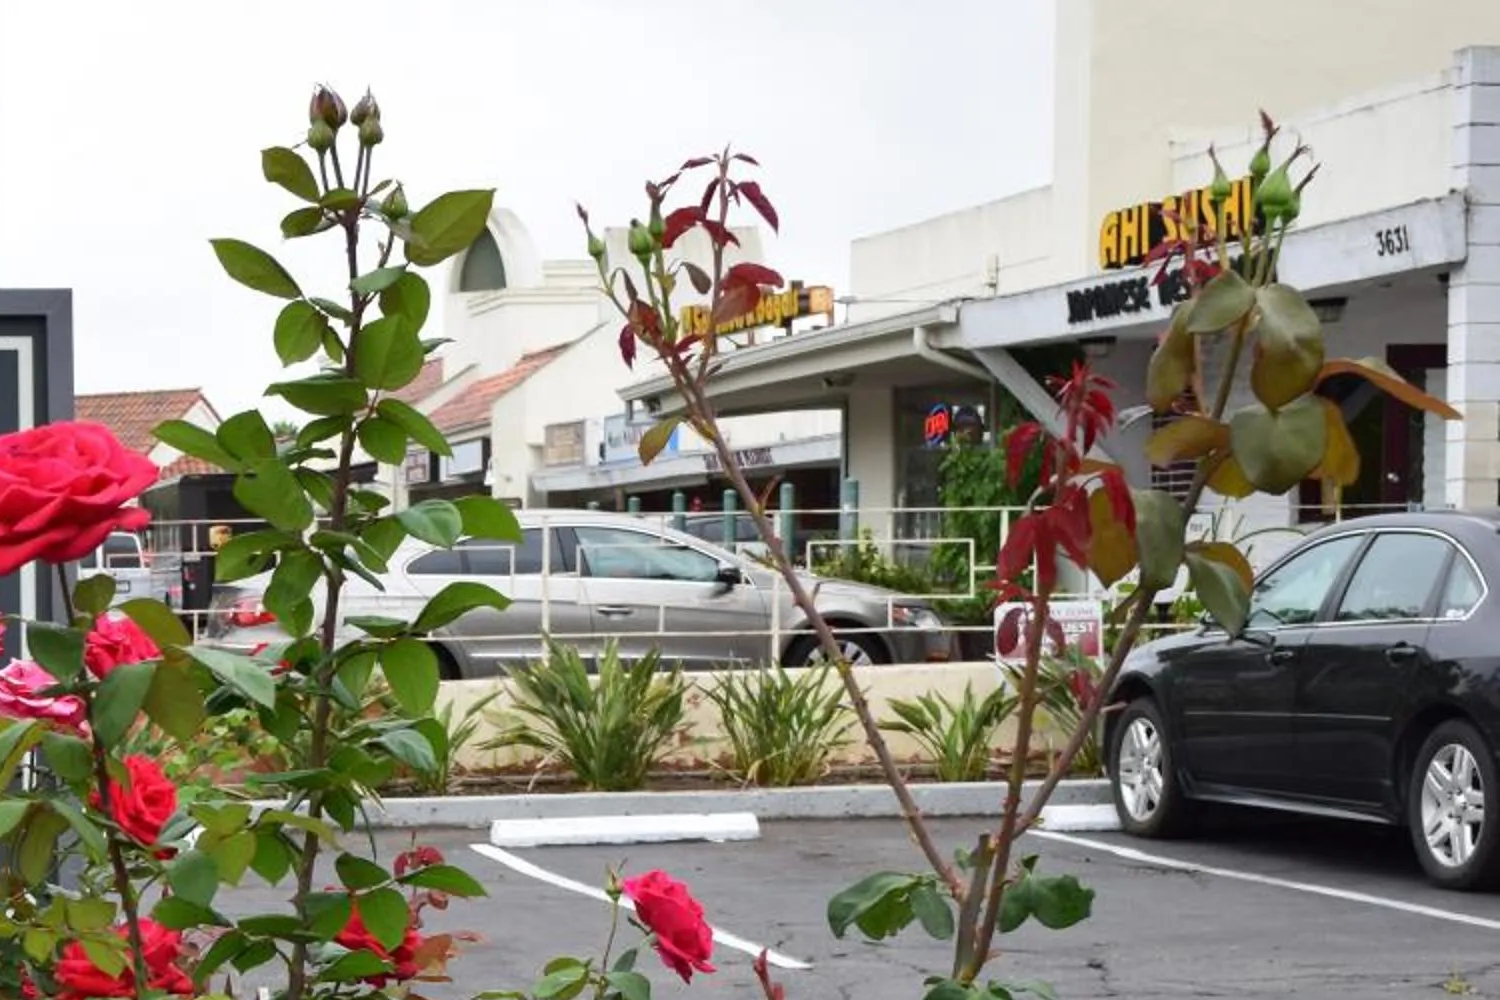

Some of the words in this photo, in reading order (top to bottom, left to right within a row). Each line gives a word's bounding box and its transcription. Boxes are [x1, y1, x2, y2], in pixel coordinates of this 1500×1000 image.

[1099, 203, 1151, 269] AHI
[1162, 175, 1255, 246] SUSHI
[1375, 225, 1410, 257] 3631
